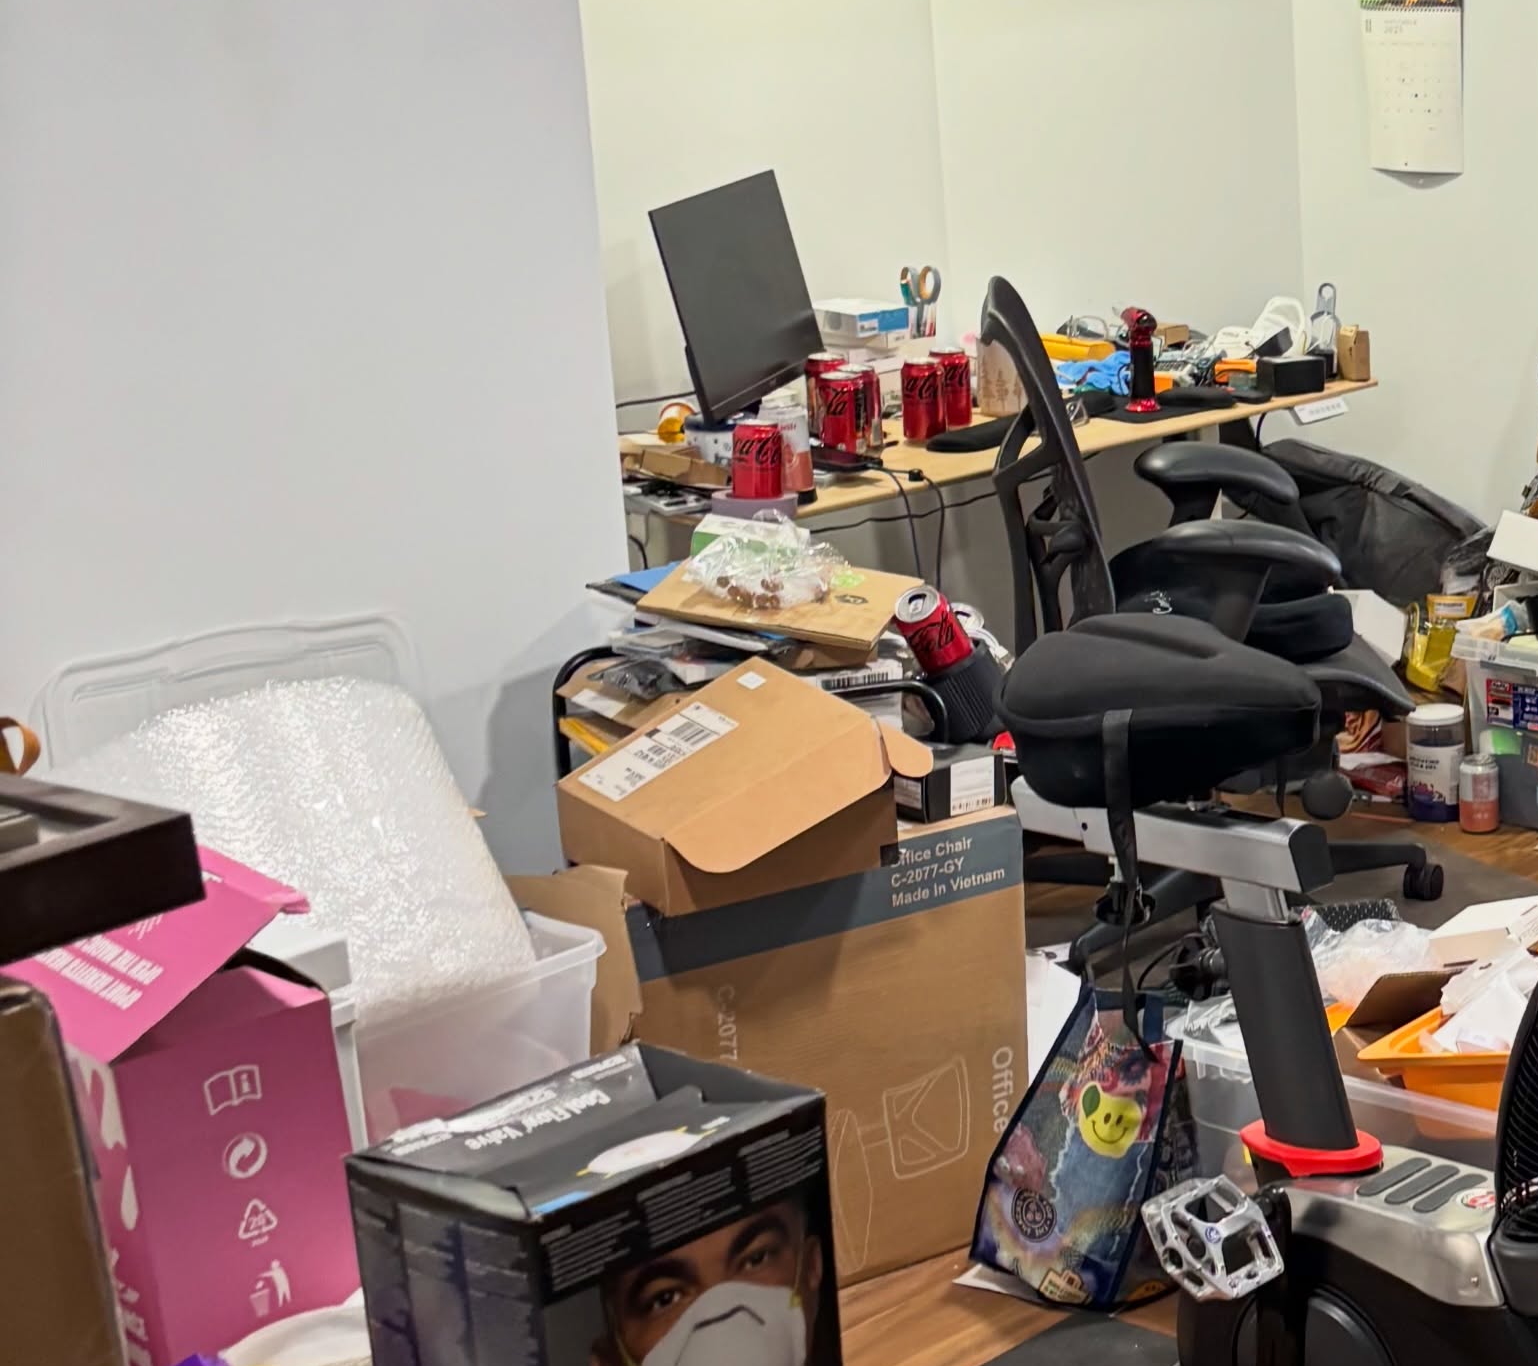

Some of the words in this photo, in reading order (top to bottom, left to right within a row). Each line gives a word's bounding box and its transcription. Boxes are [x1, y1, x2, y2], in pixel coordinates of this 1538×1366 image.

[935, 836, 973, 857] Chair
[891, 856, 964, 888] C-2077-GY
[892, 887, 930, 907] Made
[950, 868, 1005, 891] Vietnam
[991, 1046, 1014, 1133] Office
